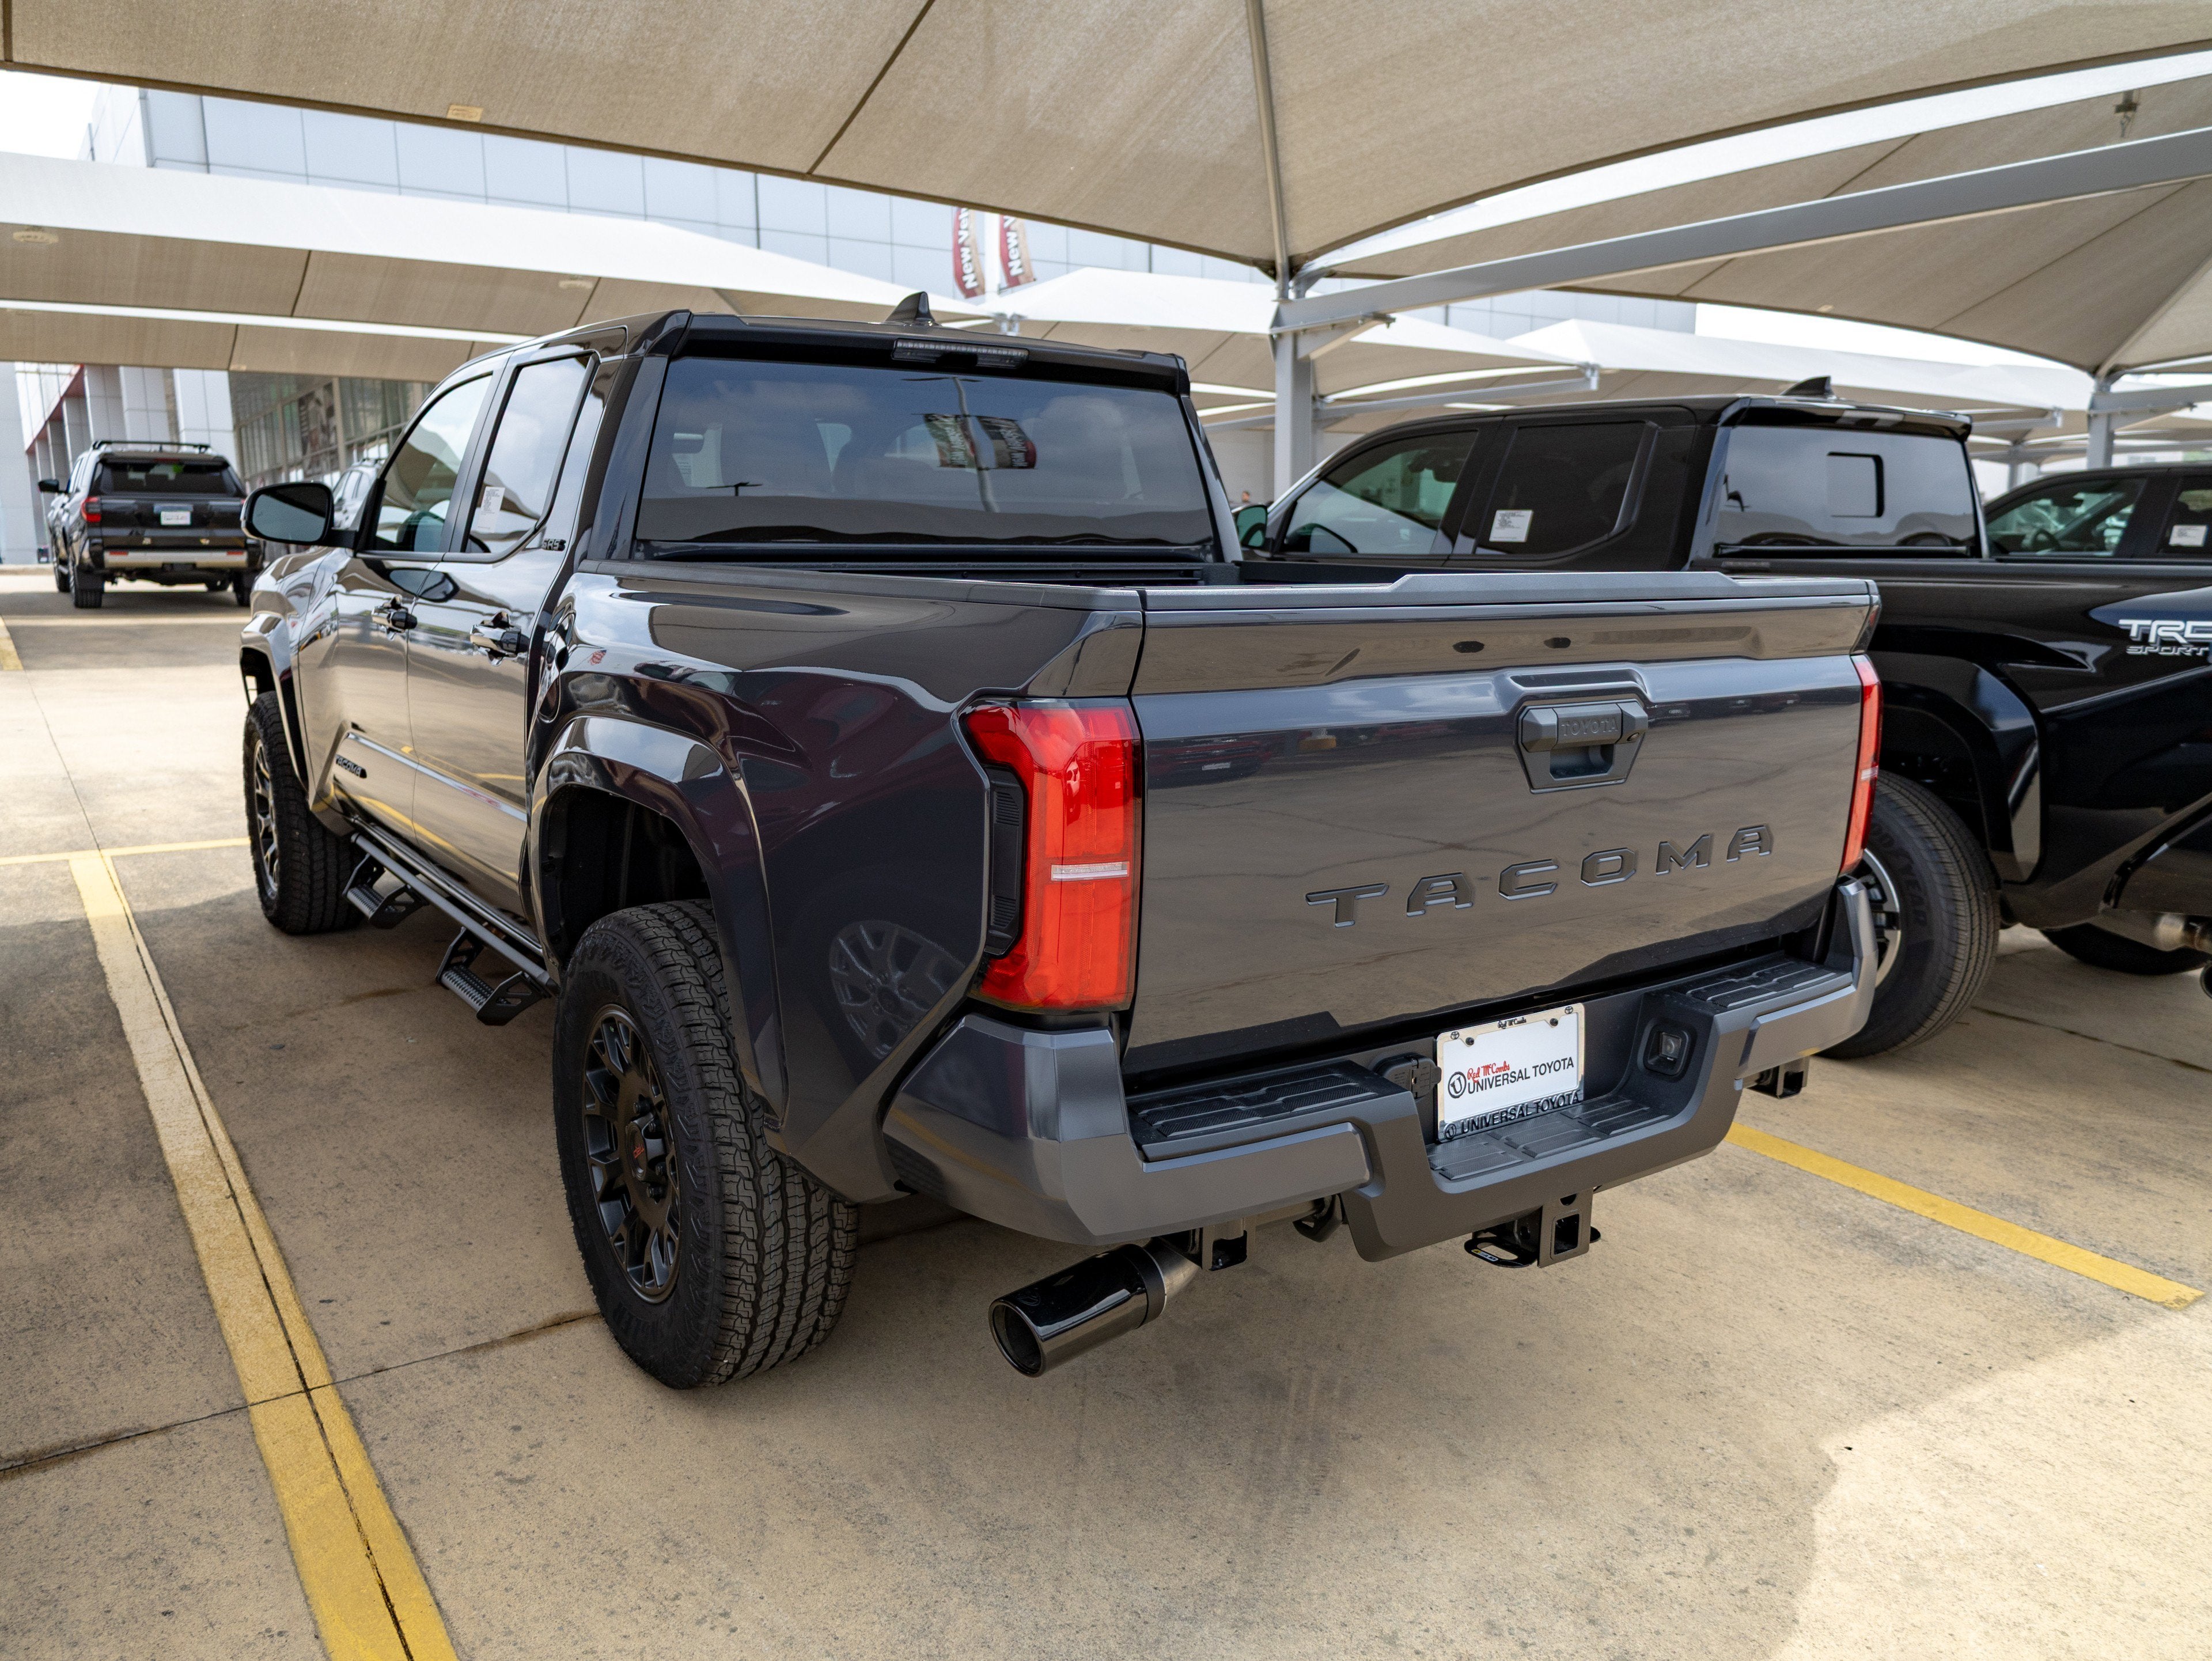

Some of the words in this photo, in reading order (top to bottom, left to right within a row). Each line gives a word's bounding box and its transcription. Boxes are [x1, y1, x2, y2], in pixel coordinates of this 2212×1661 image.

[960, 247, 979, 289] New
[1006, 232, 1024, 277] New
[2126, 645, 2210, 656] SPORT
[1561, 716, 1619, 736] TOYOTA
[335, 754, 363, 777] TACOMA
[1305, 824, 1773, 928] TACOMA
[1467, 1068, 1480, 1084] Red
[1481, 1061, 1510, 1076] McCombs
[1468, 1068, 1531, 1094] UNIVERSAL
[1532, 1057, 1574, 1077] TOYOTA
[1460, 1103, 1532, 1134] UNIVERSAL
[1533, 1089, 1581, 1114] TOYOTA
